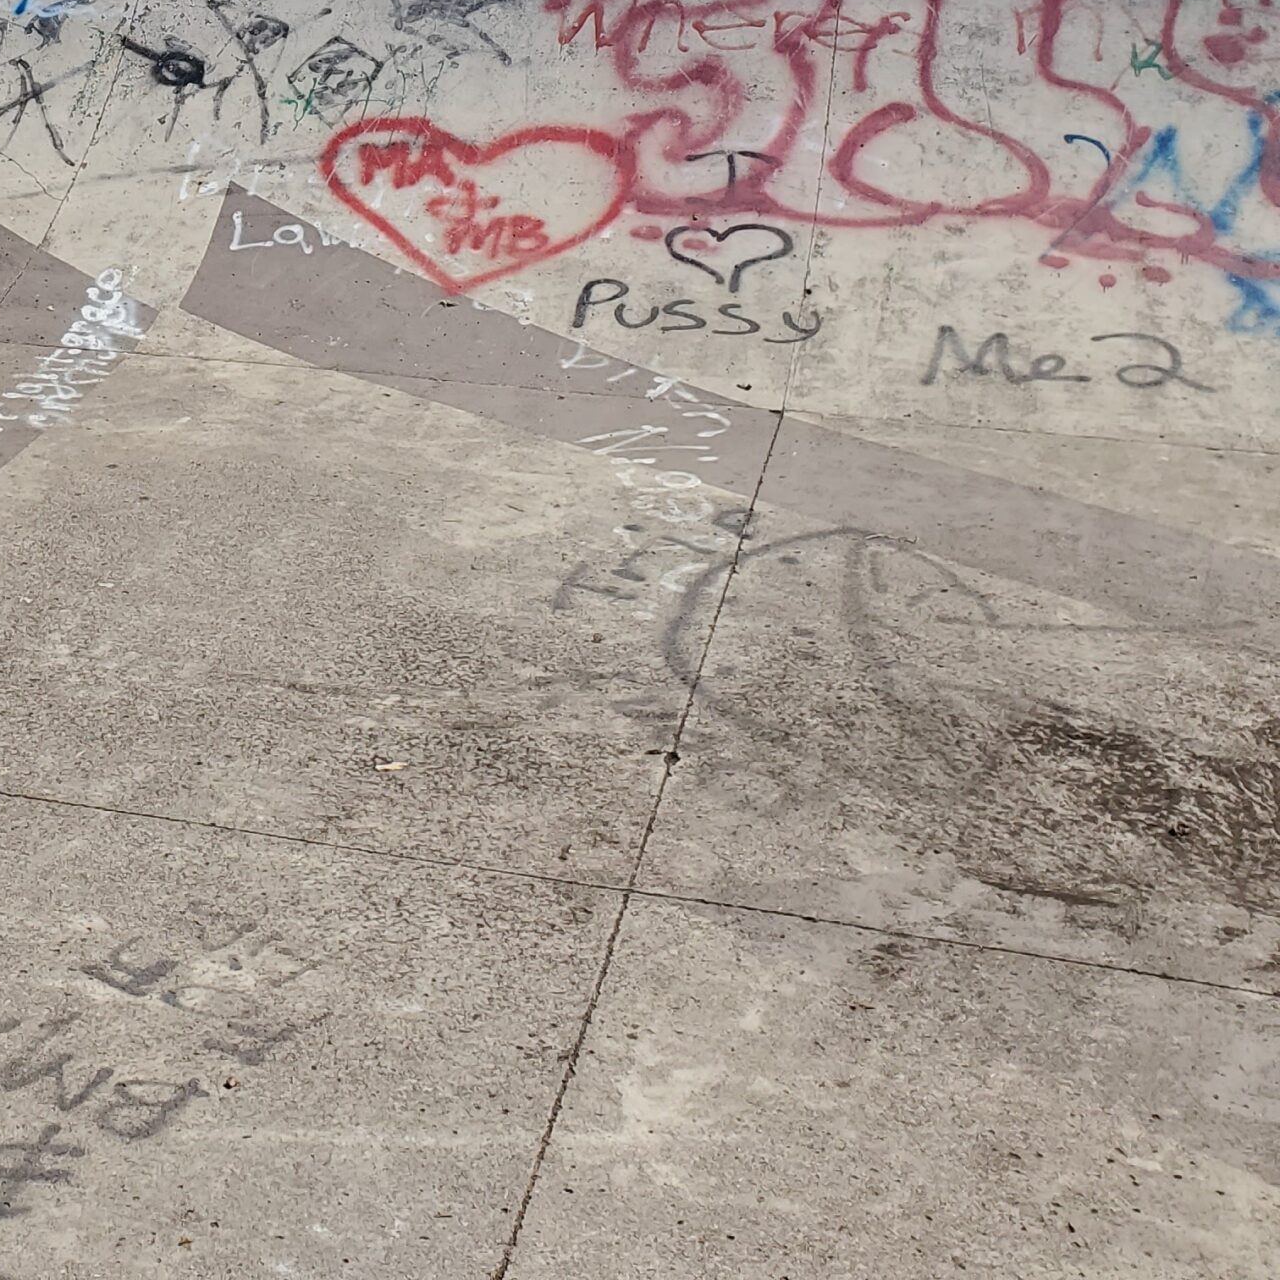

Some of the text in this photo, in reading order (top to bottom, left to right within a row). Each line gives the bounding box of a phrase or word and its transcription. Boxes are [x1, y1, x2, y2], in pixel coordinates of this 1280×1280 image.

[572, 278, 822, 344] Pussy
[919, 325, 1216, 391] Me 2
